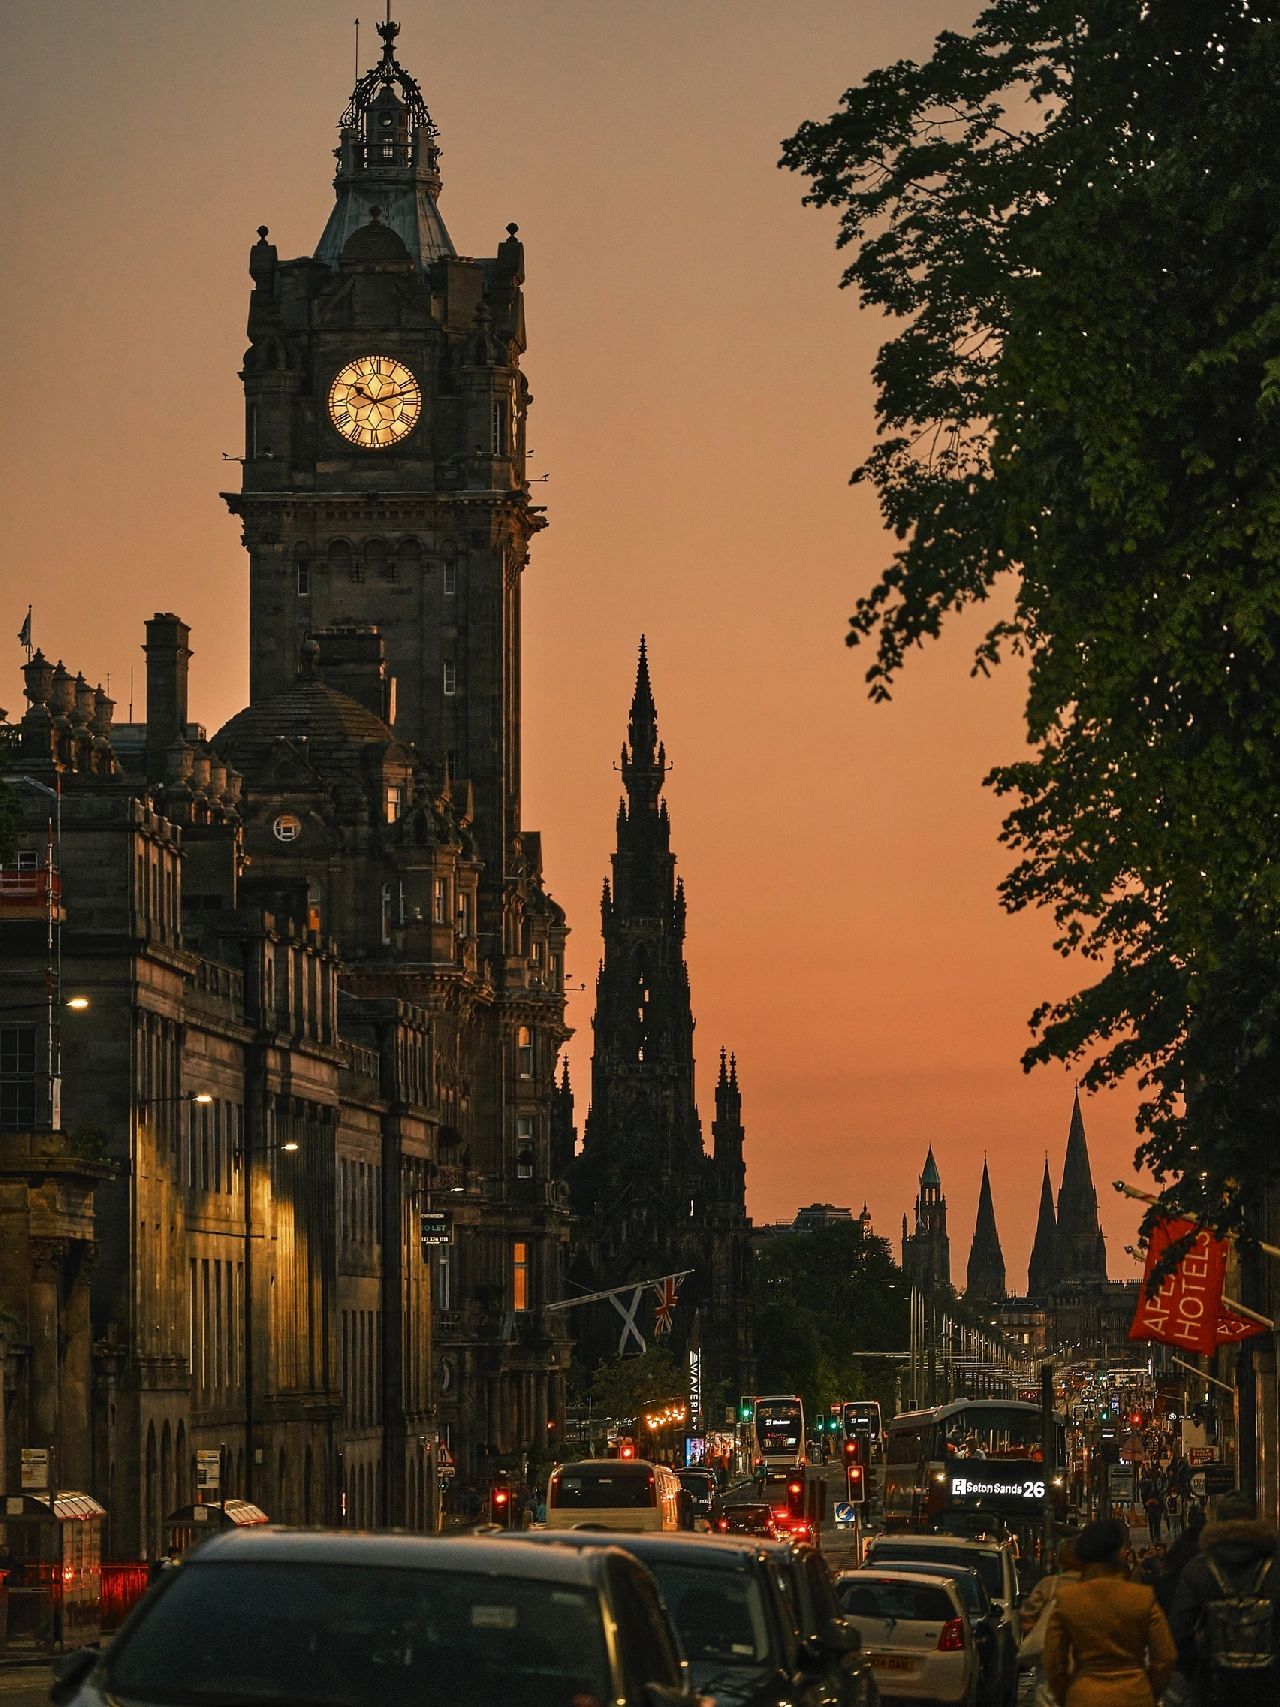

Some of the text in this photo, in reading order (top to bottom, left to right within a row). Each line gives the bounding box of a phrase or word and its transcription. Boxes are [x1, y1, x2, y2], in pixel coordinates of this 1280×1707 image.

[1143, 1267, 1176, 1335] APE
[1174, 1231, 1210, 1341] HOTELS
[966, 1482, 1045, 1497] Seton Sands 26
